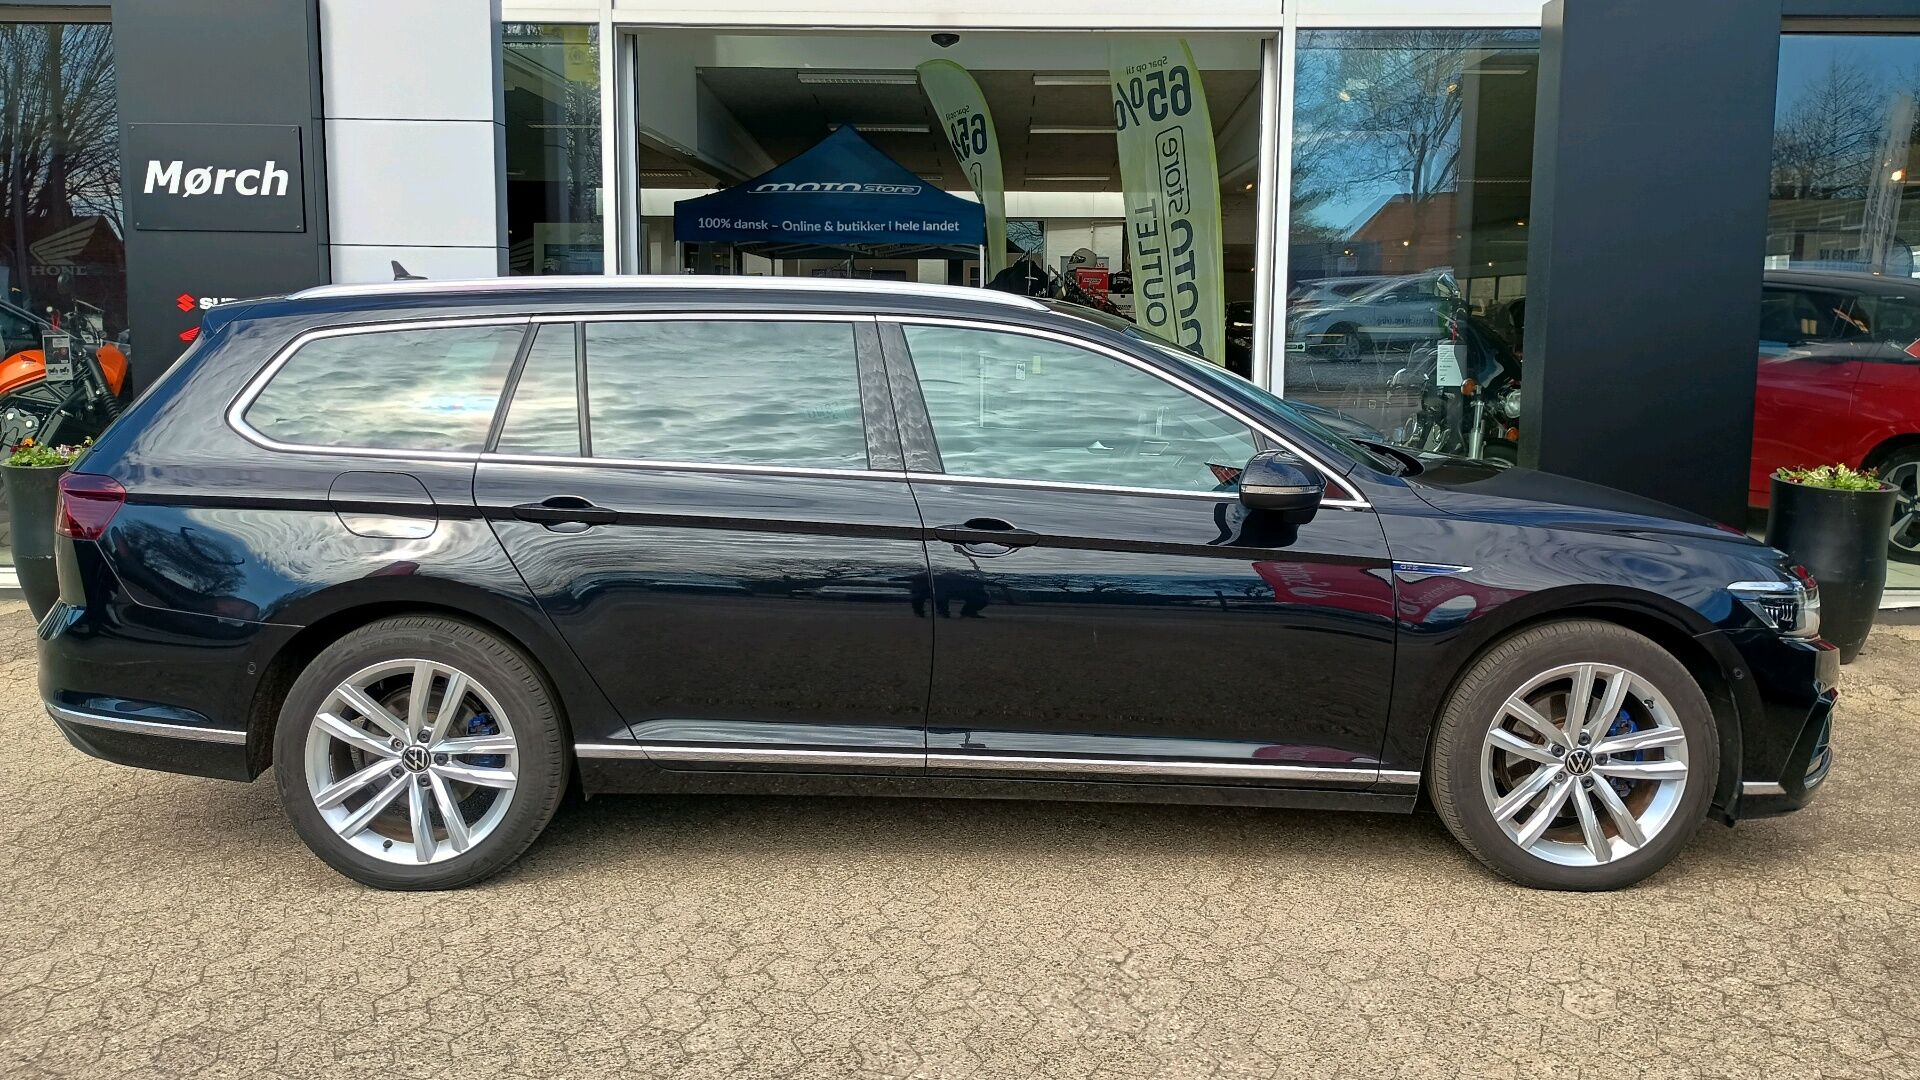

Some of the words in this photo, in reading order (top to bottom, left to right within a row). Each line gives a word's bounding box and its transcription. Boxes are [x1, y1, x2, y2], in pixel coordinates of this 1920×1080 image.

[144, 160, 289, 198] Mørch
[862, 184, 916, 195] store
[697, 217, 731, 229] 100%
[734, 218, 769, 230] dansk
[782, 220, 822, 231] Online
[824, 221, 834, 231] &
[836, 220, 885, 231] butikker
[895, 221, 919, 231] hele
[922, 220, 959, 231] landet
